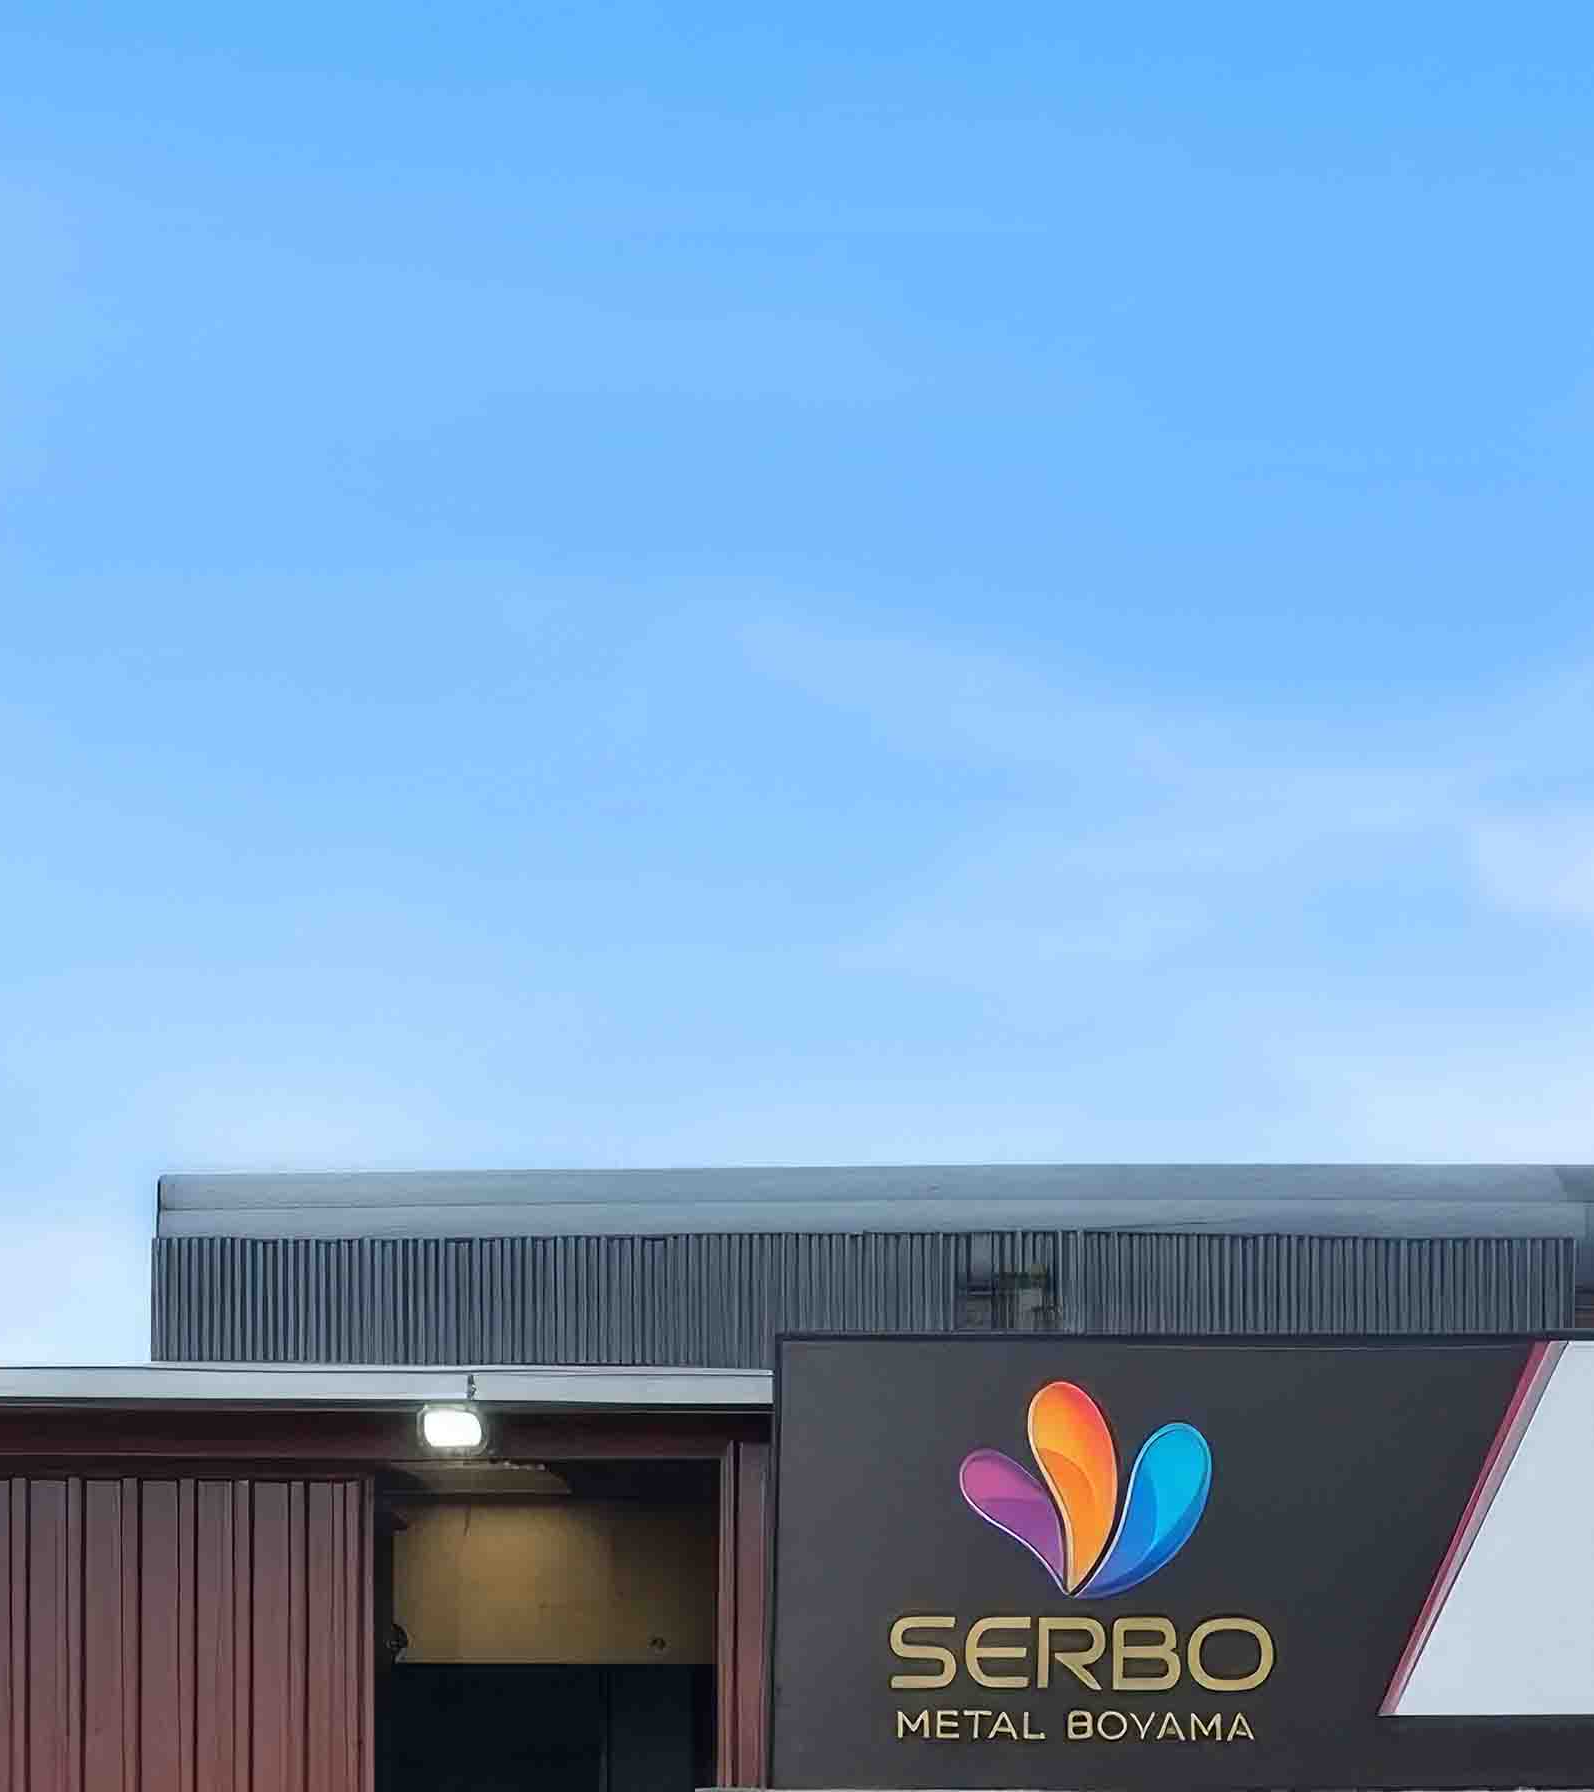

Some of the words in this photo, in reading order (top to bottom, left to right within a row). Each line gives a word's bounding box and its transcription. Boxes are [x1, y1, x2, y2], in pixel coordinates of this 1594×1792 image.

[889, 1615, 1275, 1692] SERBO
[896, 1709, 1046, 1741] METAL
[1066, 1709, 1256, 1743] BOYAMA
